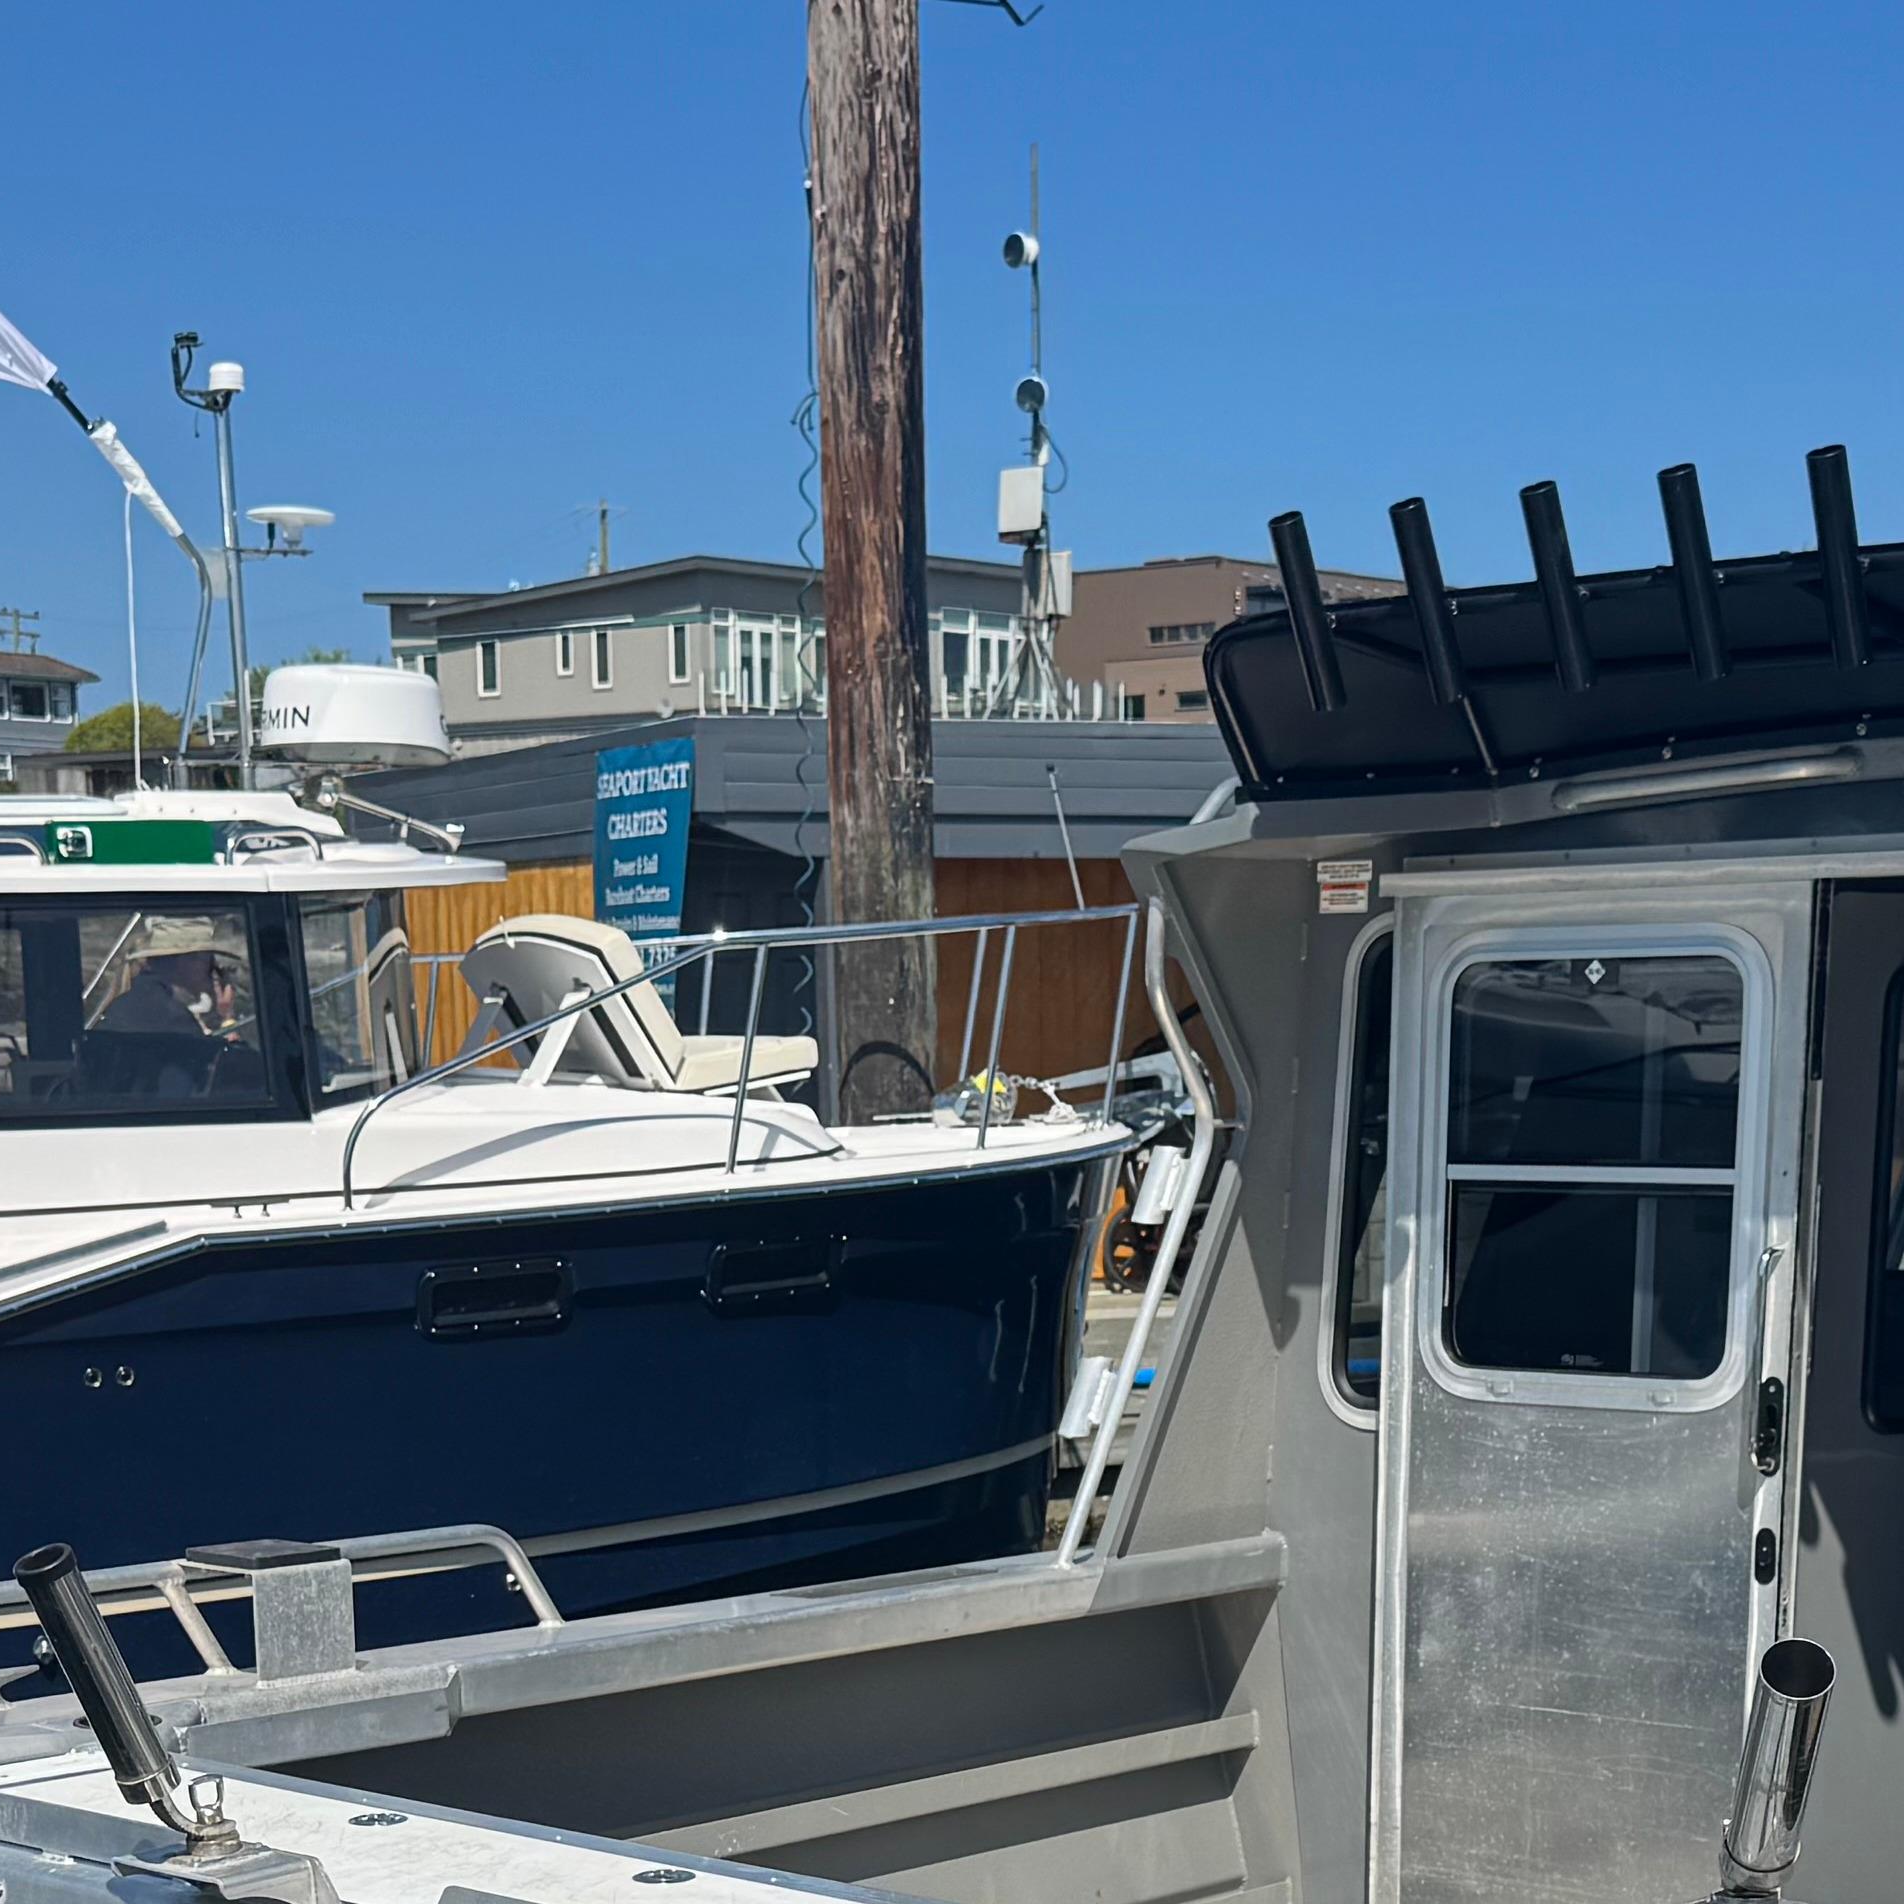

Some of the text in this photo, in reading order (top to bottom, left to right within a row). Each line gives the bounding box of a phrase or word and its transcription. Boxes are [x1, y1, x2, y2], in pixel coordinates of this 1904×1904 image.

[597, 762, 689, 800] SEAPORT YACHT
[607, 807, 667, 840] CHARTERS
